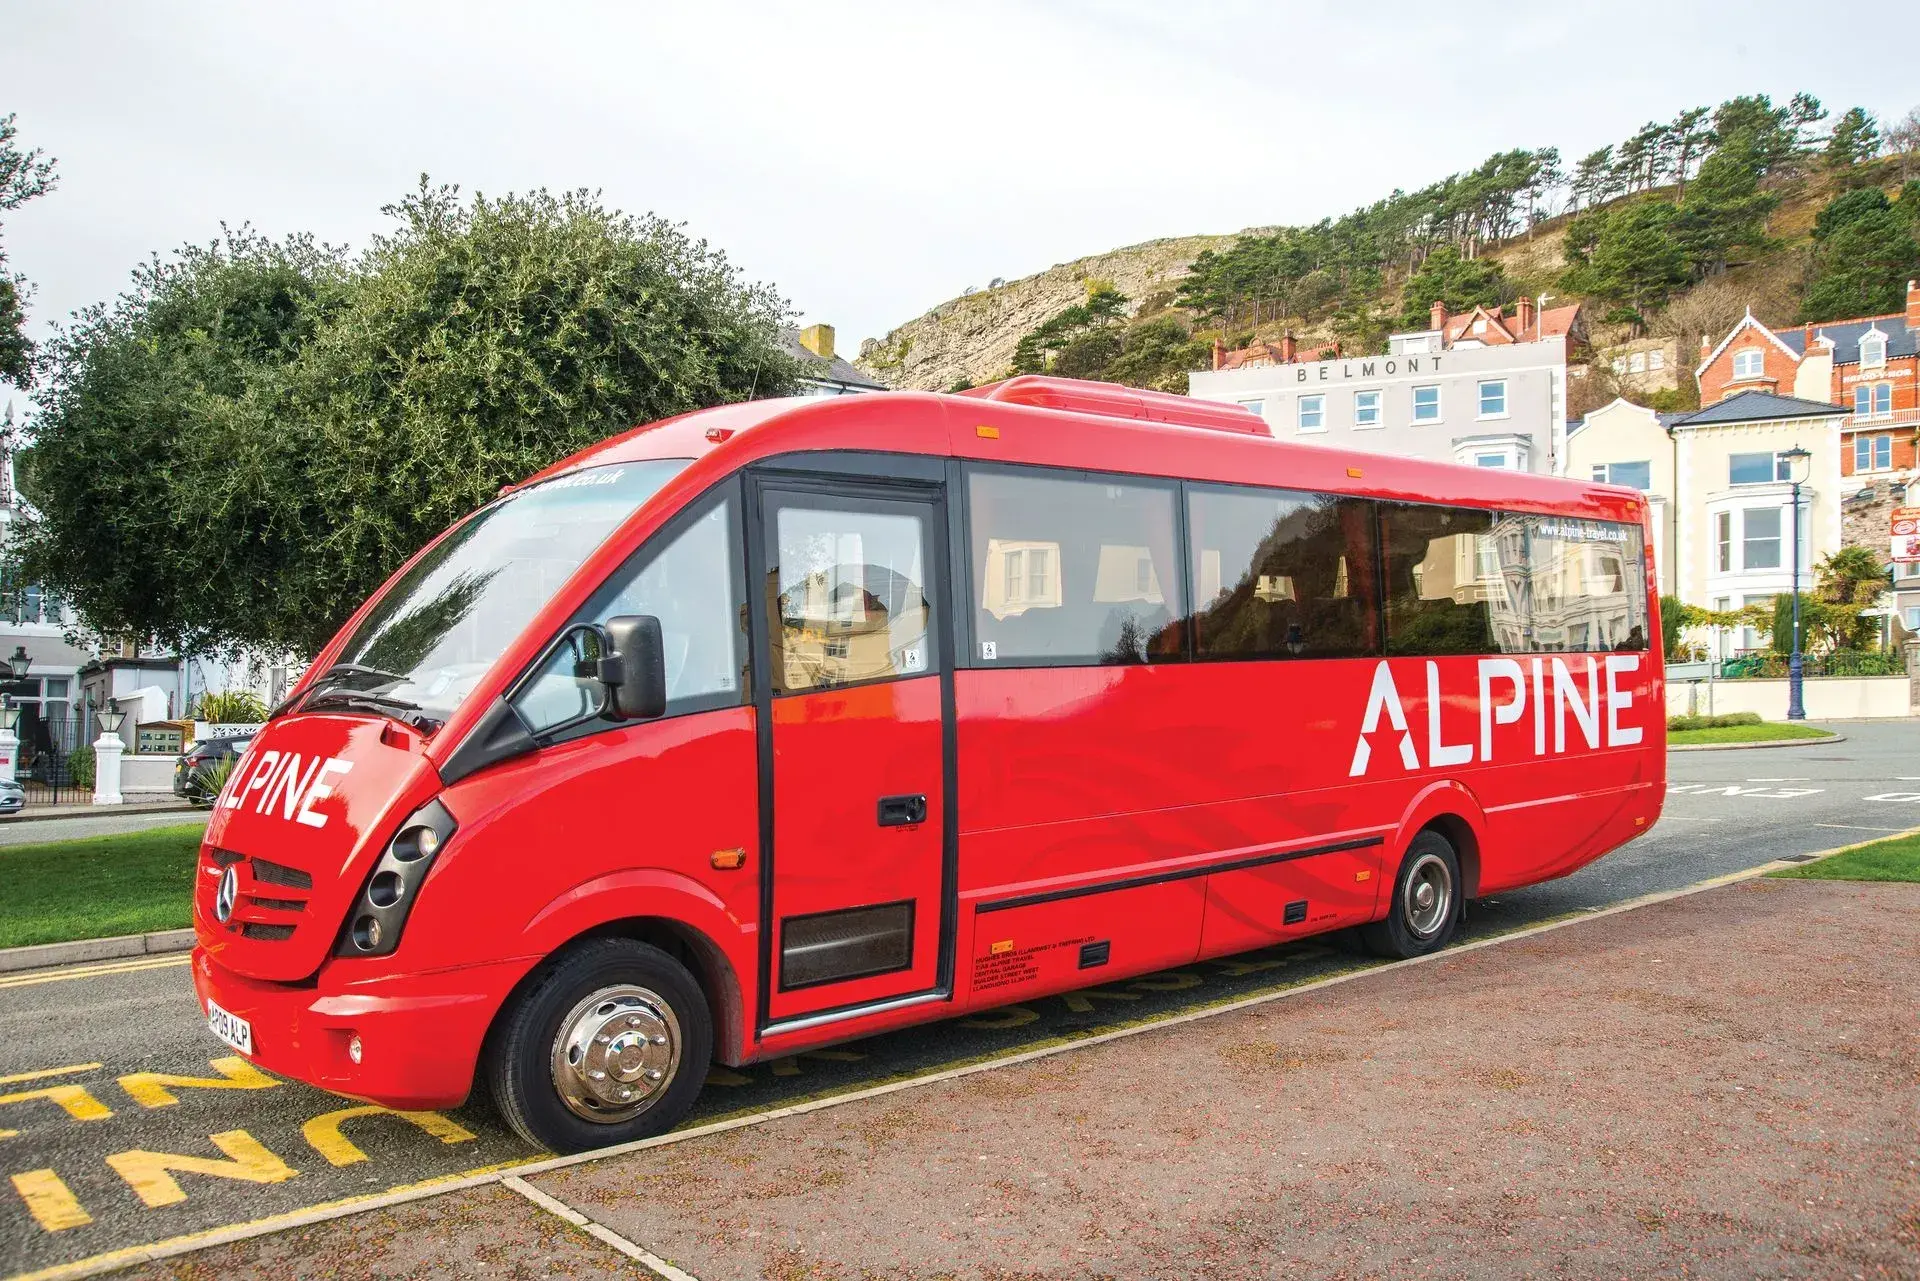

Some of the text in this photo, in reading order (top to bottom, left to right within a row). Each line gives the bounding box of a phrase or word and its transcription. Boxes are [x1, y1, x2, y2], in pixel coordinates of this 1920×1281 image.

[1297, 356, 1442, 382] BELMONT
[1540, 524, 1628, 541] www.alpine-travel.co.uk
[1349, 654, 1643, 777] ALPINE
[975, 953, 1000, 964] HUGHES
[1001, 950, 1018, 959] BROS
[991, 959, 1011, 967] ALPINE
[1012, 954, 1034, 963] TRAVEL
[974, 963, 1026, 978] CENTRAL GARAGE
[1000, 970, 1022, 979] STREET
[1023, 966, 1040, 975] WEST
[230, 1018, 248, 1048] ALP
